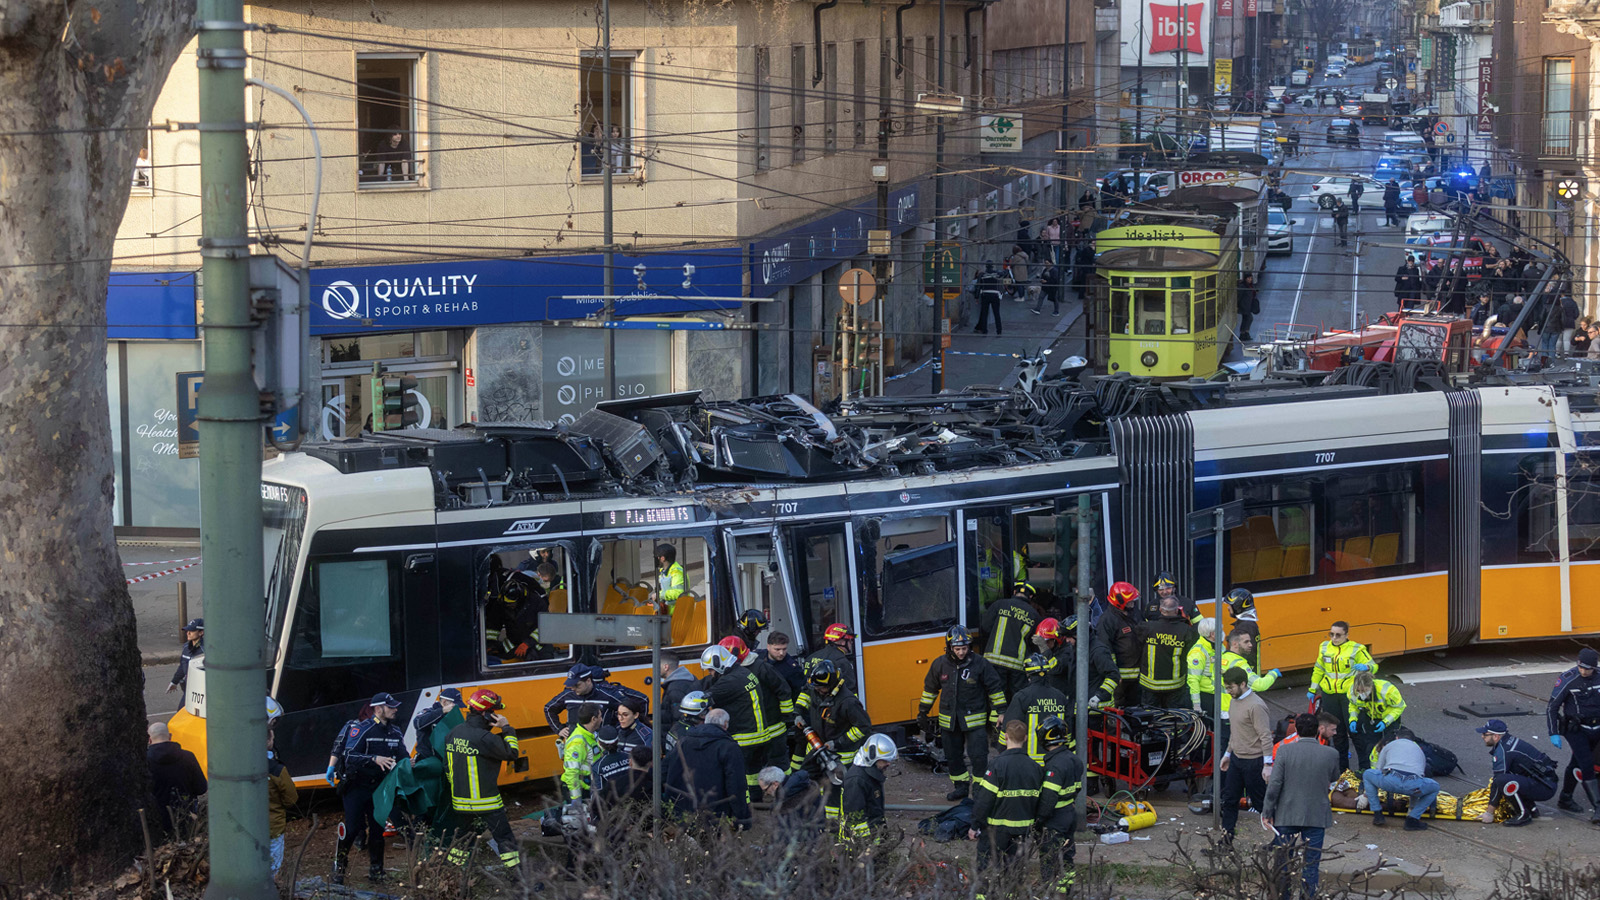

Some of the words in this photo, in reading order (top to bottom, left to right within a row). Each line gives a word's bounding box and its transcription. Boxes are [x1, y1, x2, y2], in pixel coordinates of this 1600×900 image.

[1158, 17, 1195, 36] ibis
[1481, 66, 1490, 123] BRIANZA
[1125, 229, 1185, 242] idealista
[374, 274, 478, 303] QUALITY
[374, 305, 418, 317] SPORT
[422, 304, 431, 314] &
[435, 301, 478, 313] REHAB
[584, 358, 606, 371] ME
[584, 383, 645, 399] PHSIO
[1315, 452, 1336, 463] 7707
[772, 502, 798, 513] 7707
[610, 510, 616, 524] 9
[677, 507, 689, 520] FS
[517, 522, 536, 531] ATM
[998, 608, 1012, 617] DEL
[1010, 605, 1029, 617] VIGILI
[1156, 632, 1177, 641] VIGILI
[191, 691, 204, 704] 7707
[1037, 698, 1057, 706] VIGILI
[601, 761, 620, 772] POLIZIA
[620, 759, 630, 767] LOC
